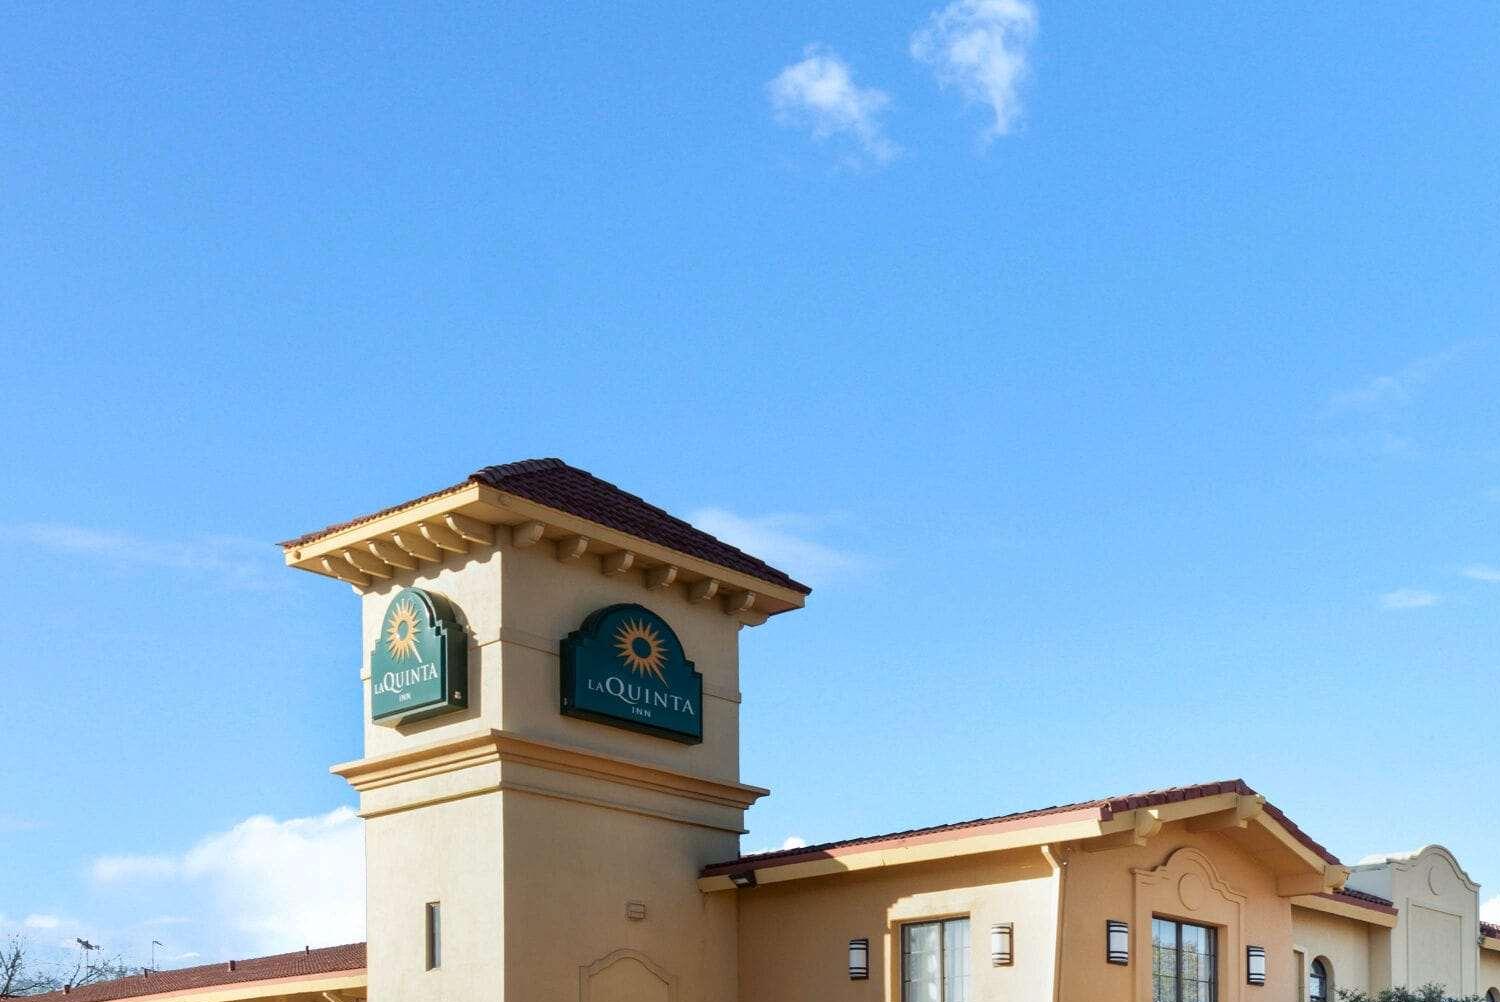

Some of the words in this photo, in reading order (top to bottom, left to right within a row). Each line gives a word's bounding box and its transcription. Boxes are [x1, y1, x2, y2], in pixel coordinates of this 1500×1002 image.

[374, 682, 384, 694] LA
[384, 662, 438, 693] QUINTA
[588, 679, 604, 693] LA
[606, 676, 695, 715] QUINTA
[631, 706, 651, 717] INN
